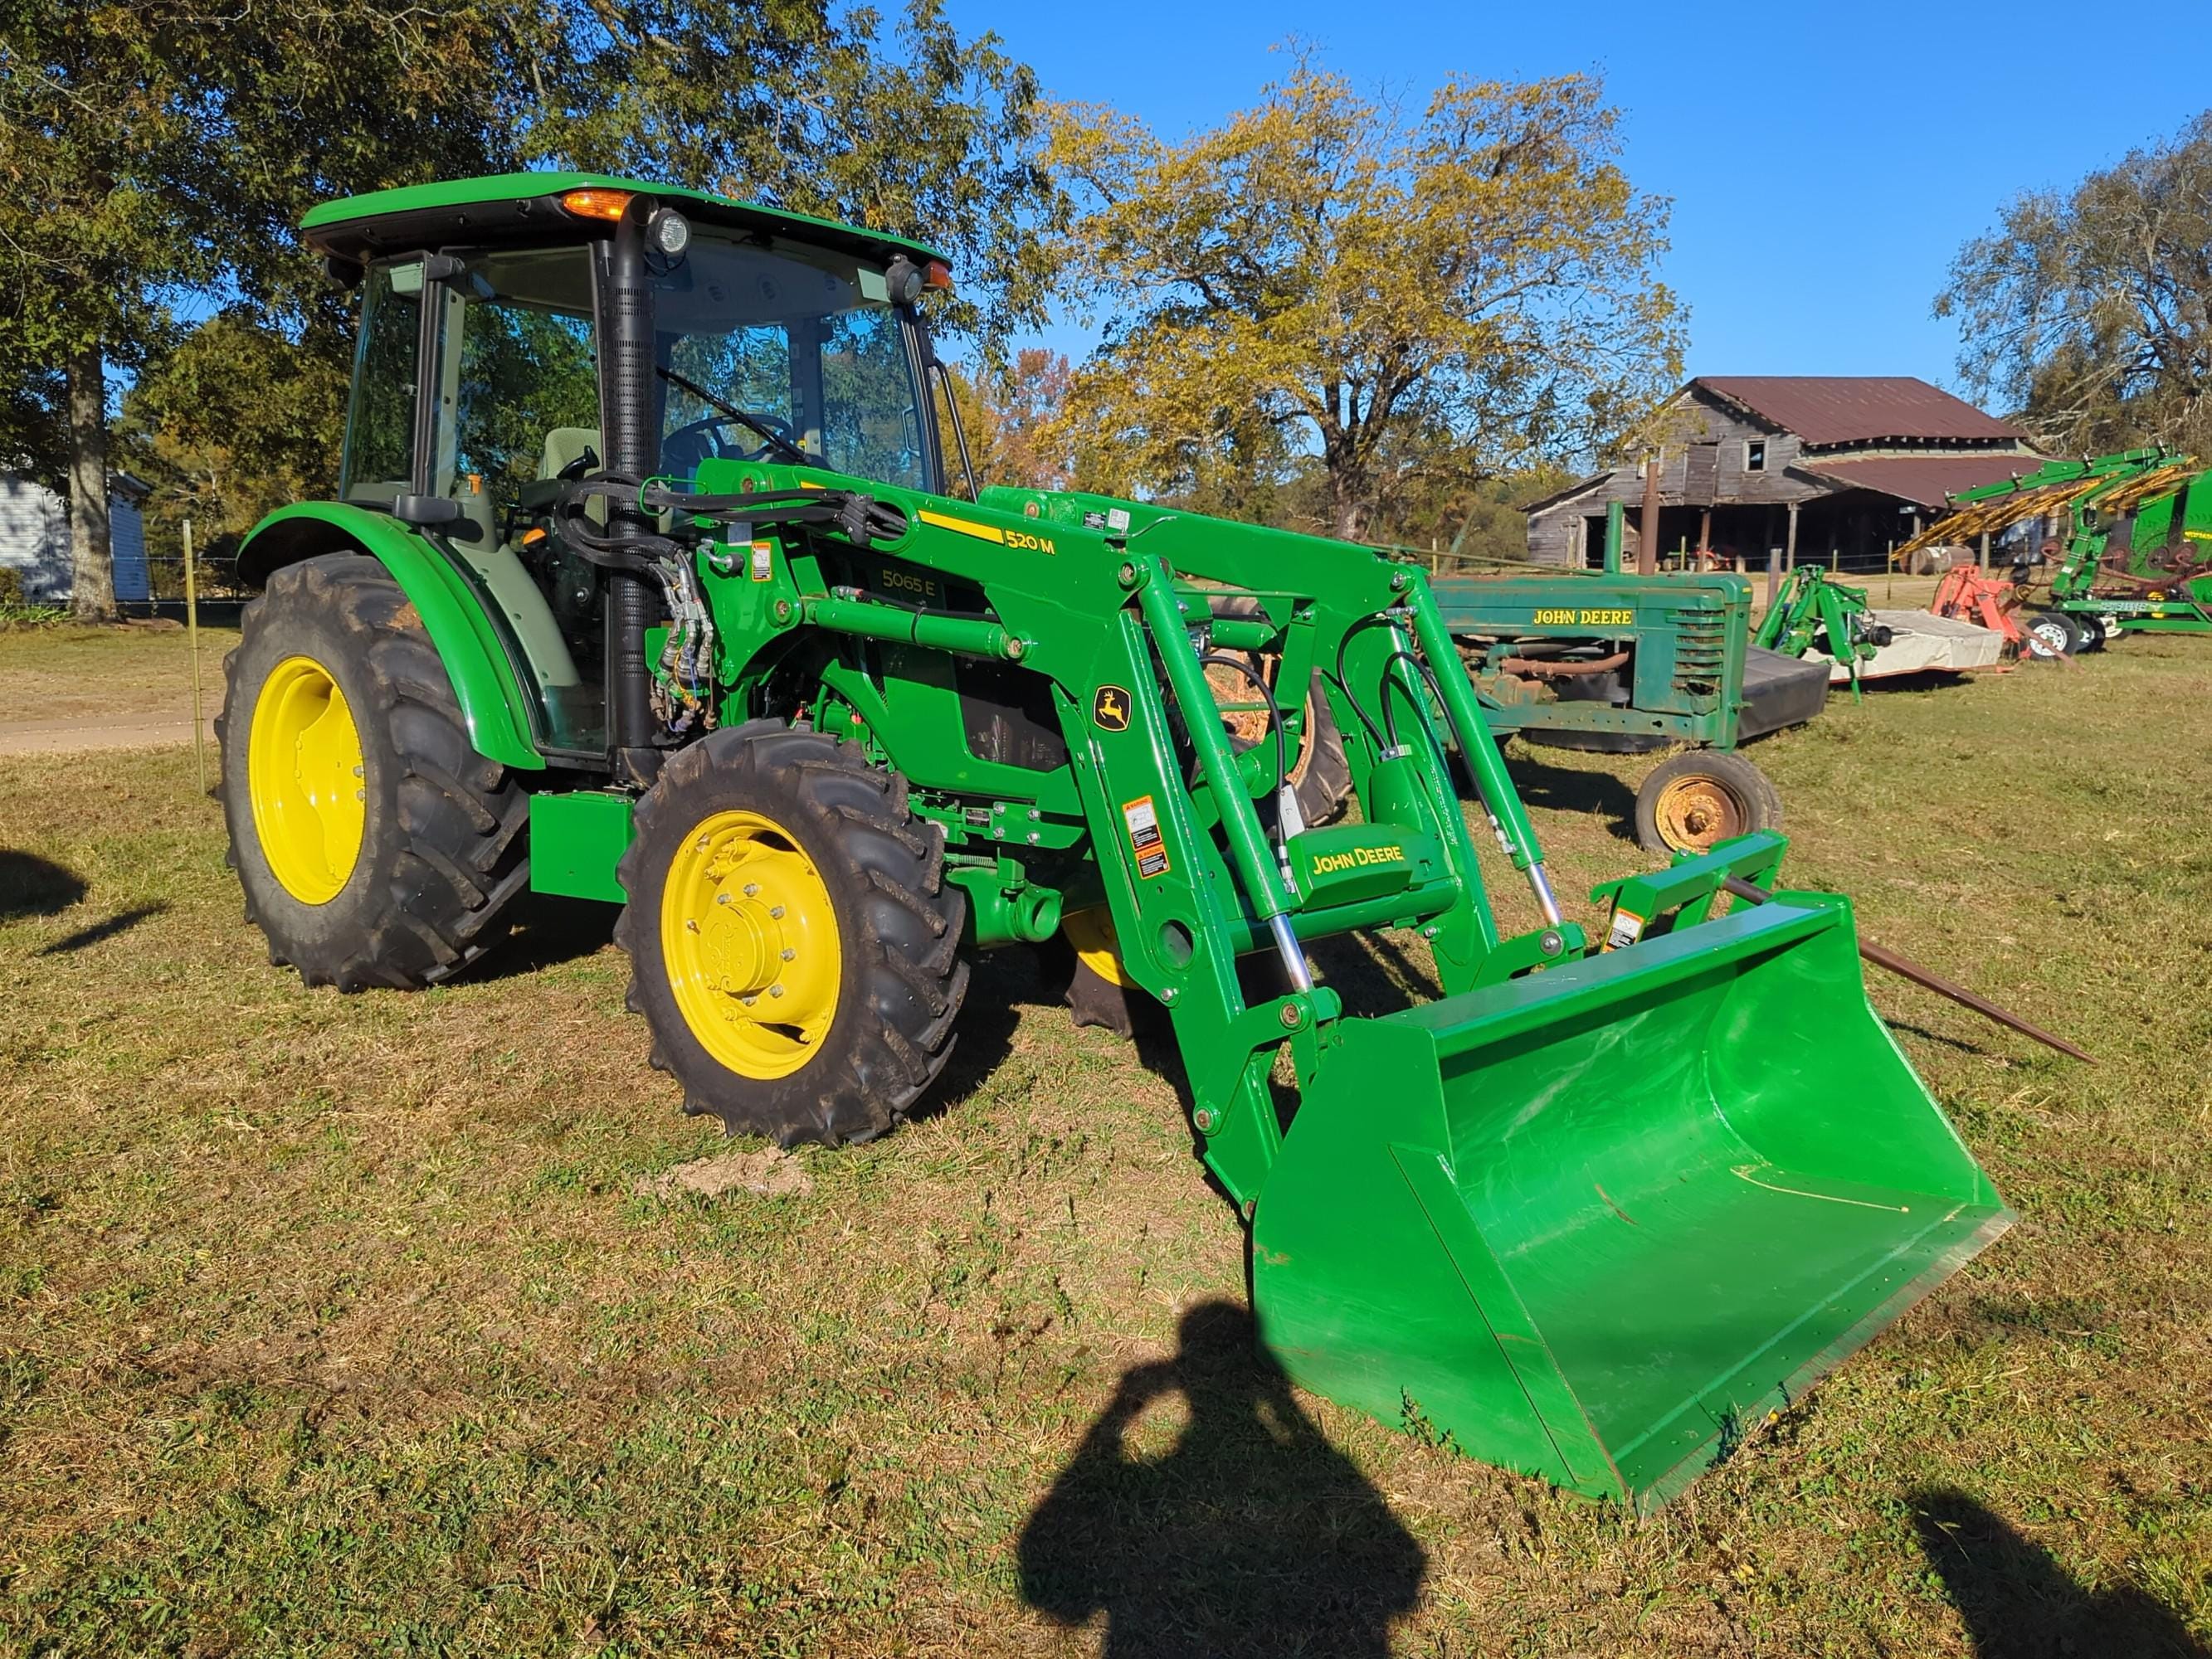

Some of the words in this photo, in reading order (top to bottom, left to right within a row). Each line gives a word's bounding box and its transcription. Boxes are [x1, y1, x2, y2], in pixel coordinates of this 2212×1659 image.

[1006, 529, 1037, 550] 520
[1040, 538, 1055, 555] M
[883, 570, 923, 592] 5065
[925, 582, 935, 596] E
[1533, 610, 1576, 624] JOHN
[1580, 610, 1631, 624] DEERE
[1313, 853, 1356, 875] JOHN
[1354, 846, 1405, 865] DEERE
